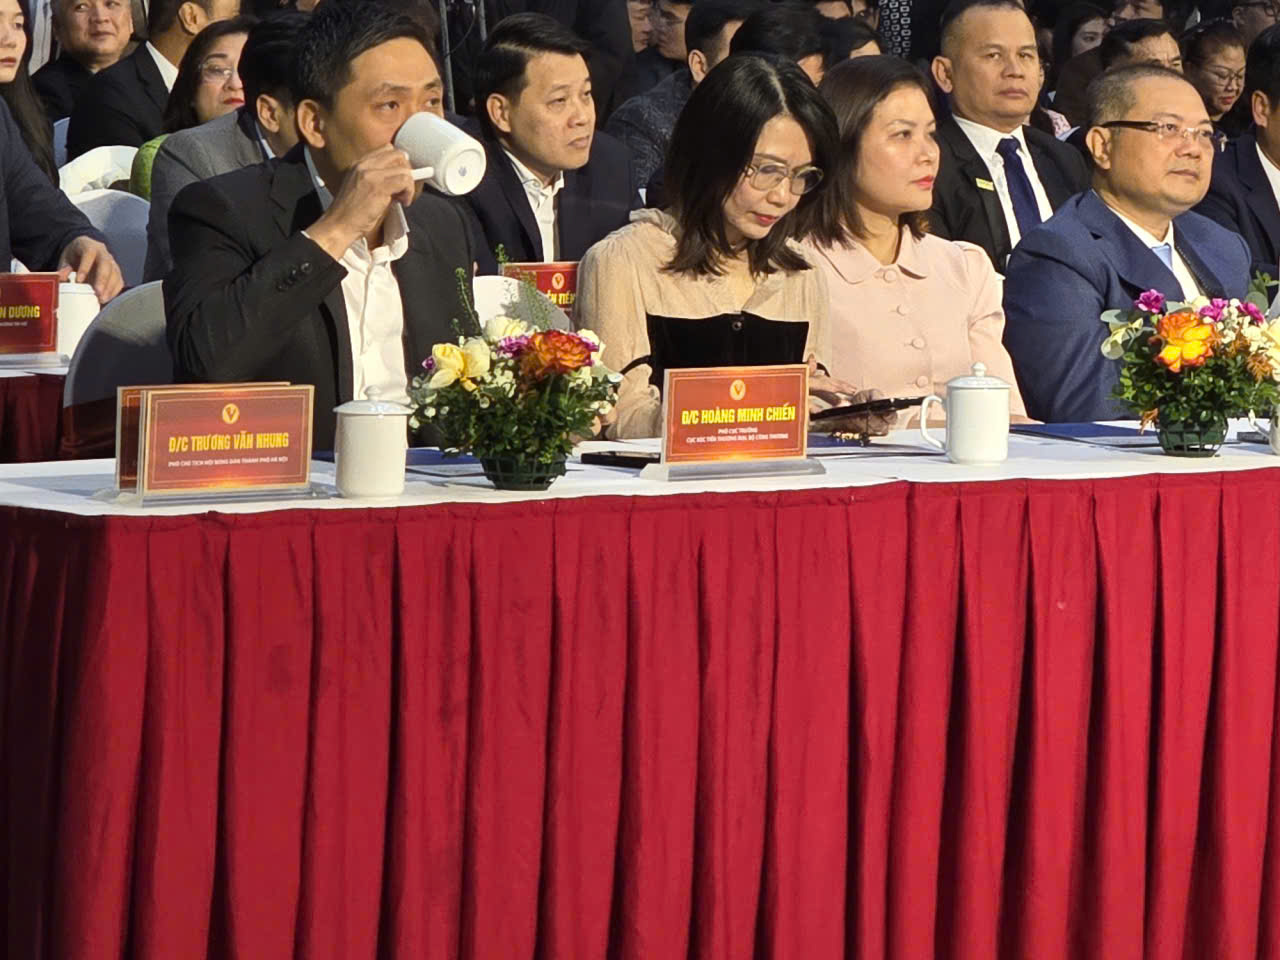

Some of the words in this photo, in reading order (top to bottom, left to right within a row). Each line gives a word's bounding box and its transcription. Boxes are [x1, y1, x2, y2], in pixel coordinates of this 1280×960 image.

[682, 409, 699, 425] Đ/C
[701, 406, 735, 424] HOÀNG
[737, 407, 764, 423] MINH
[766, 402, 796, 421] CHIẾN
[168, 436, 189, 453] Đ/C
[190, 433, 231, 452] TRƯƠNG
[233, 430, 253, 449] VĂN
[256, 432, 289, 448] NHUNG
